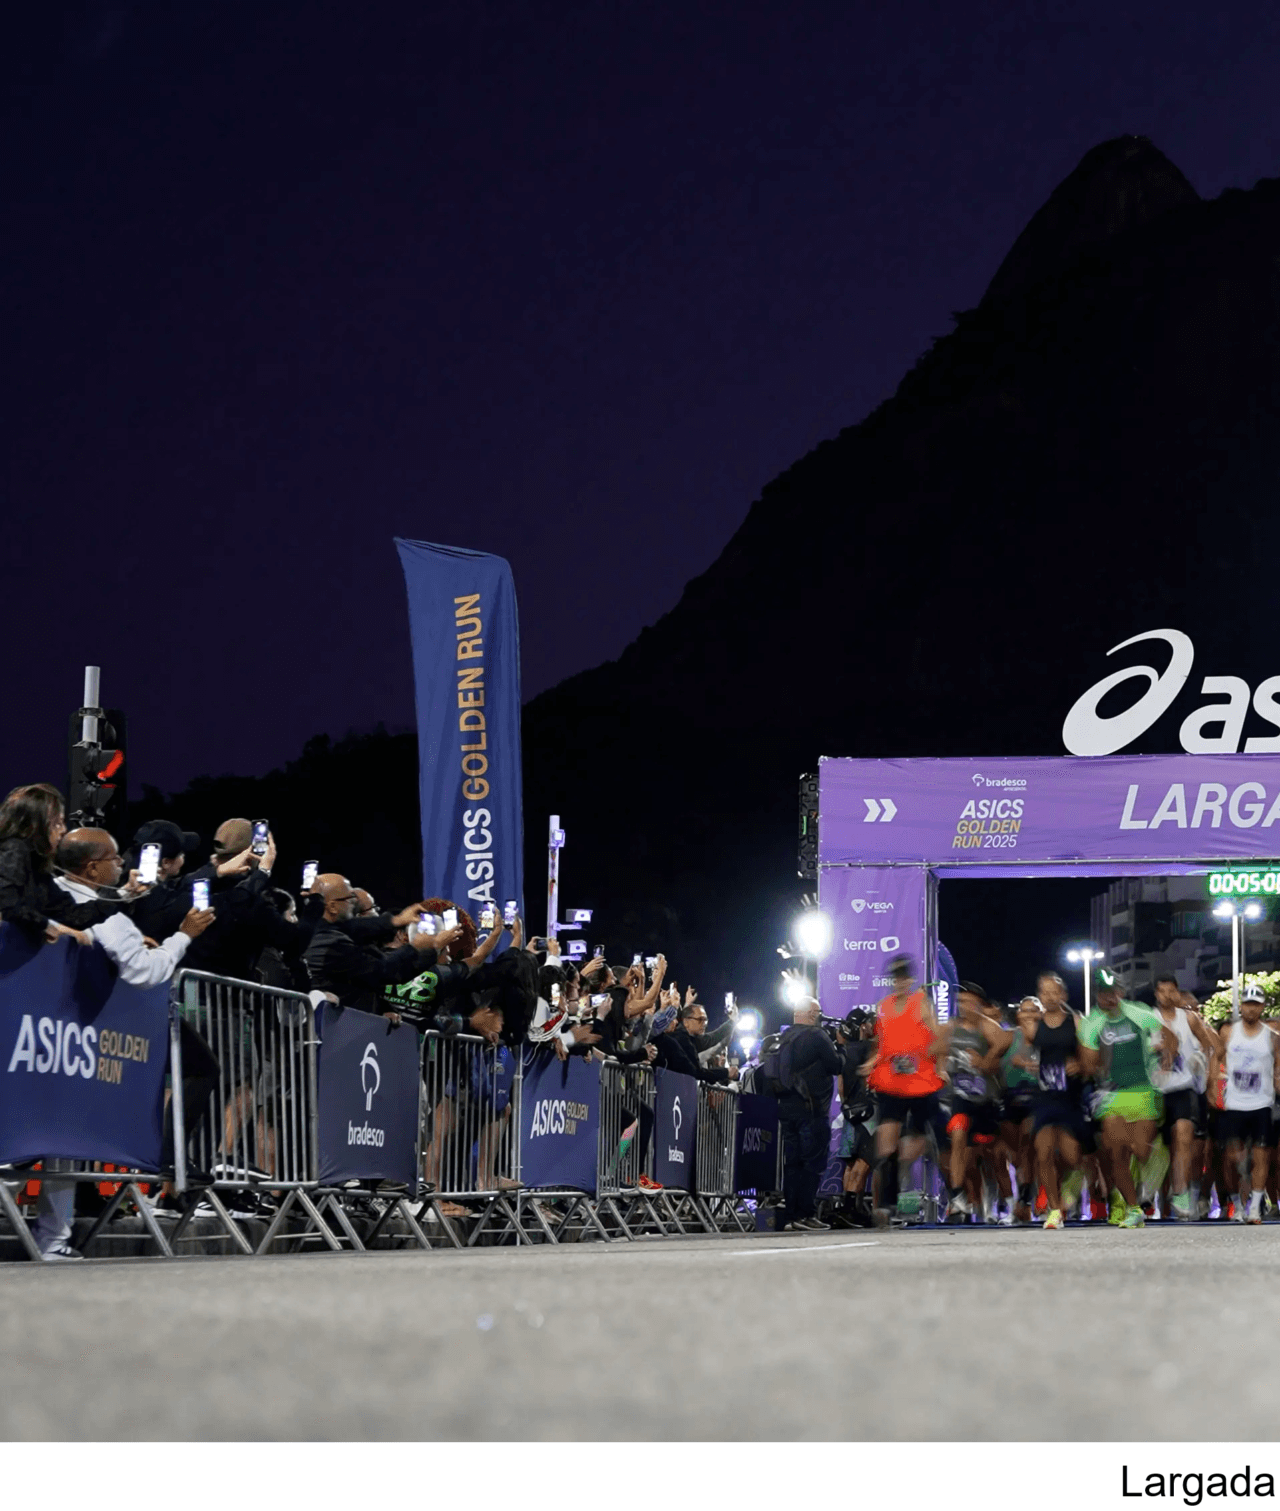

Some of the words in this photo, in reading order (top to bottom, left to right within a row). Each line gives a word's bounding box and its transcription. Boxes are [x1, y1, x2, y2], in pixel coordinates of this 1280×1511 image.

[454, 593, 484, 661] RUN
[458, 667, 491, 801] GOLDEN
[986, 777, 1027, 787] bradesco
[960, 798, 1025, 819] ASICS
[956, 819, 1022, 834] GOLDEN
[952, 835, 983, 849] RUN
[983, 834, 1018, 848] 2025
[464, 807, 495, 903] ASICS
[866, 902, 894, 910] VEGA
[843, 938, 877, 950] terra
[847, 973, 861, 981] Rio
[8, 1014, 98, 1080] ASICS
[99, 1029, 149, 1063] GOLDEN
[97, 1058, 122, 1085] RUN
[529, 1099, 567, 1140] ASICS
[566, 1100, 589, 1122] GOLDEN
[348, 1120, 385, 1149] bradesco
[565, 1118, 578, 1136] RUN
[742, 1126, 762, 1155] ASICS
[668, 1143, 685, 1164] bradesco
